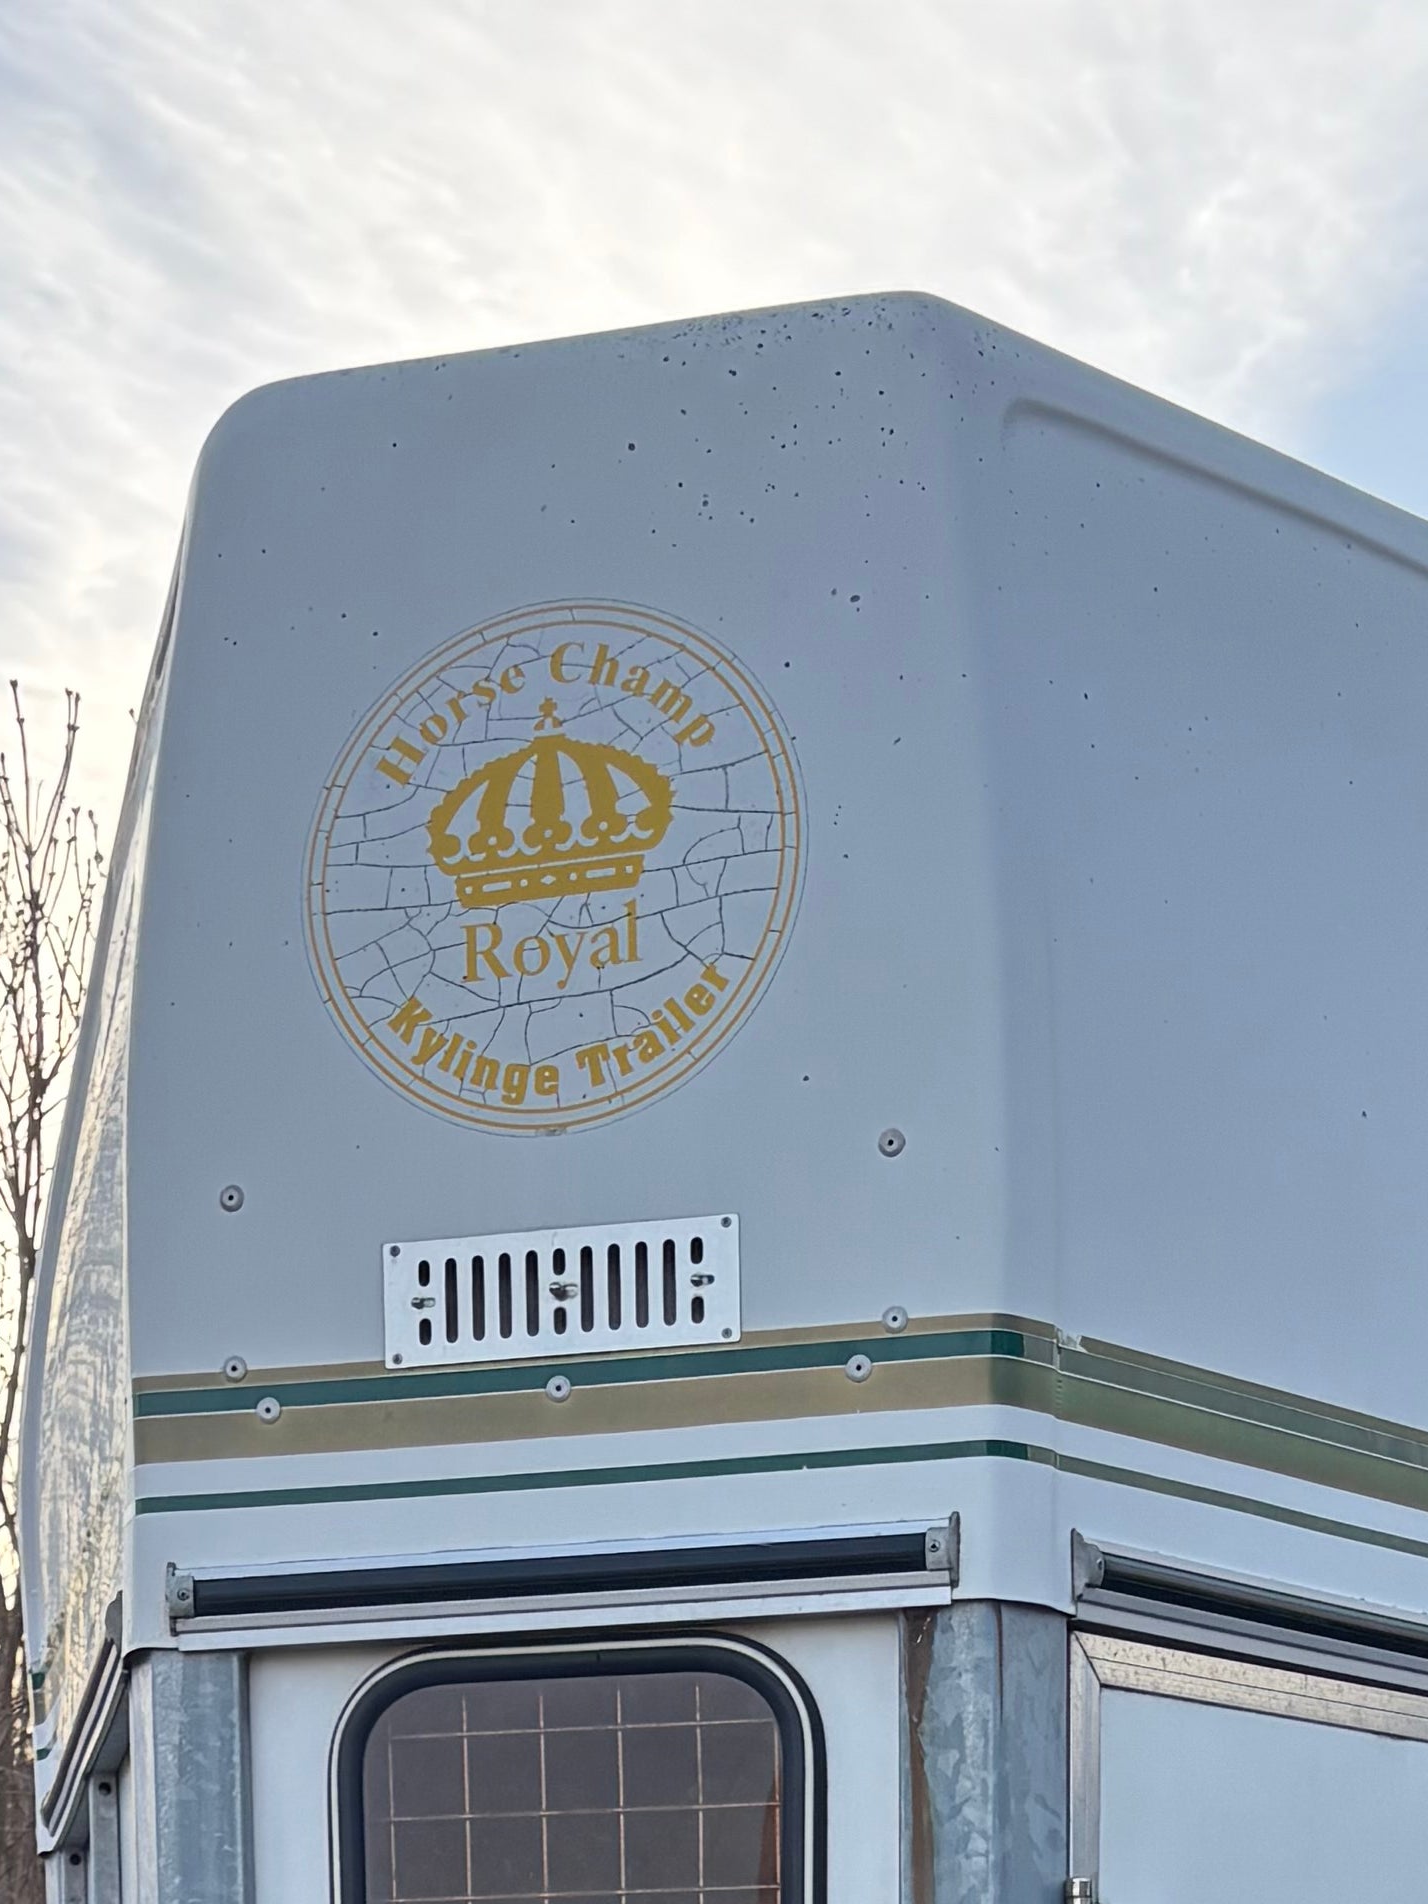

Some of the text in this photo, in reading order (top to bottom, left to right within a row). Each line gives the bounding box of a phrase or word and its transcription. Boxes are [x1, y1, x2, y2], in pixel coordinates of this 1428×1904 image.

[375, 641, 716, 788] Horse Champ
[460, 899, 644, 988] Royal
[387, 962, 731, 1105] Kylinge Trailer
